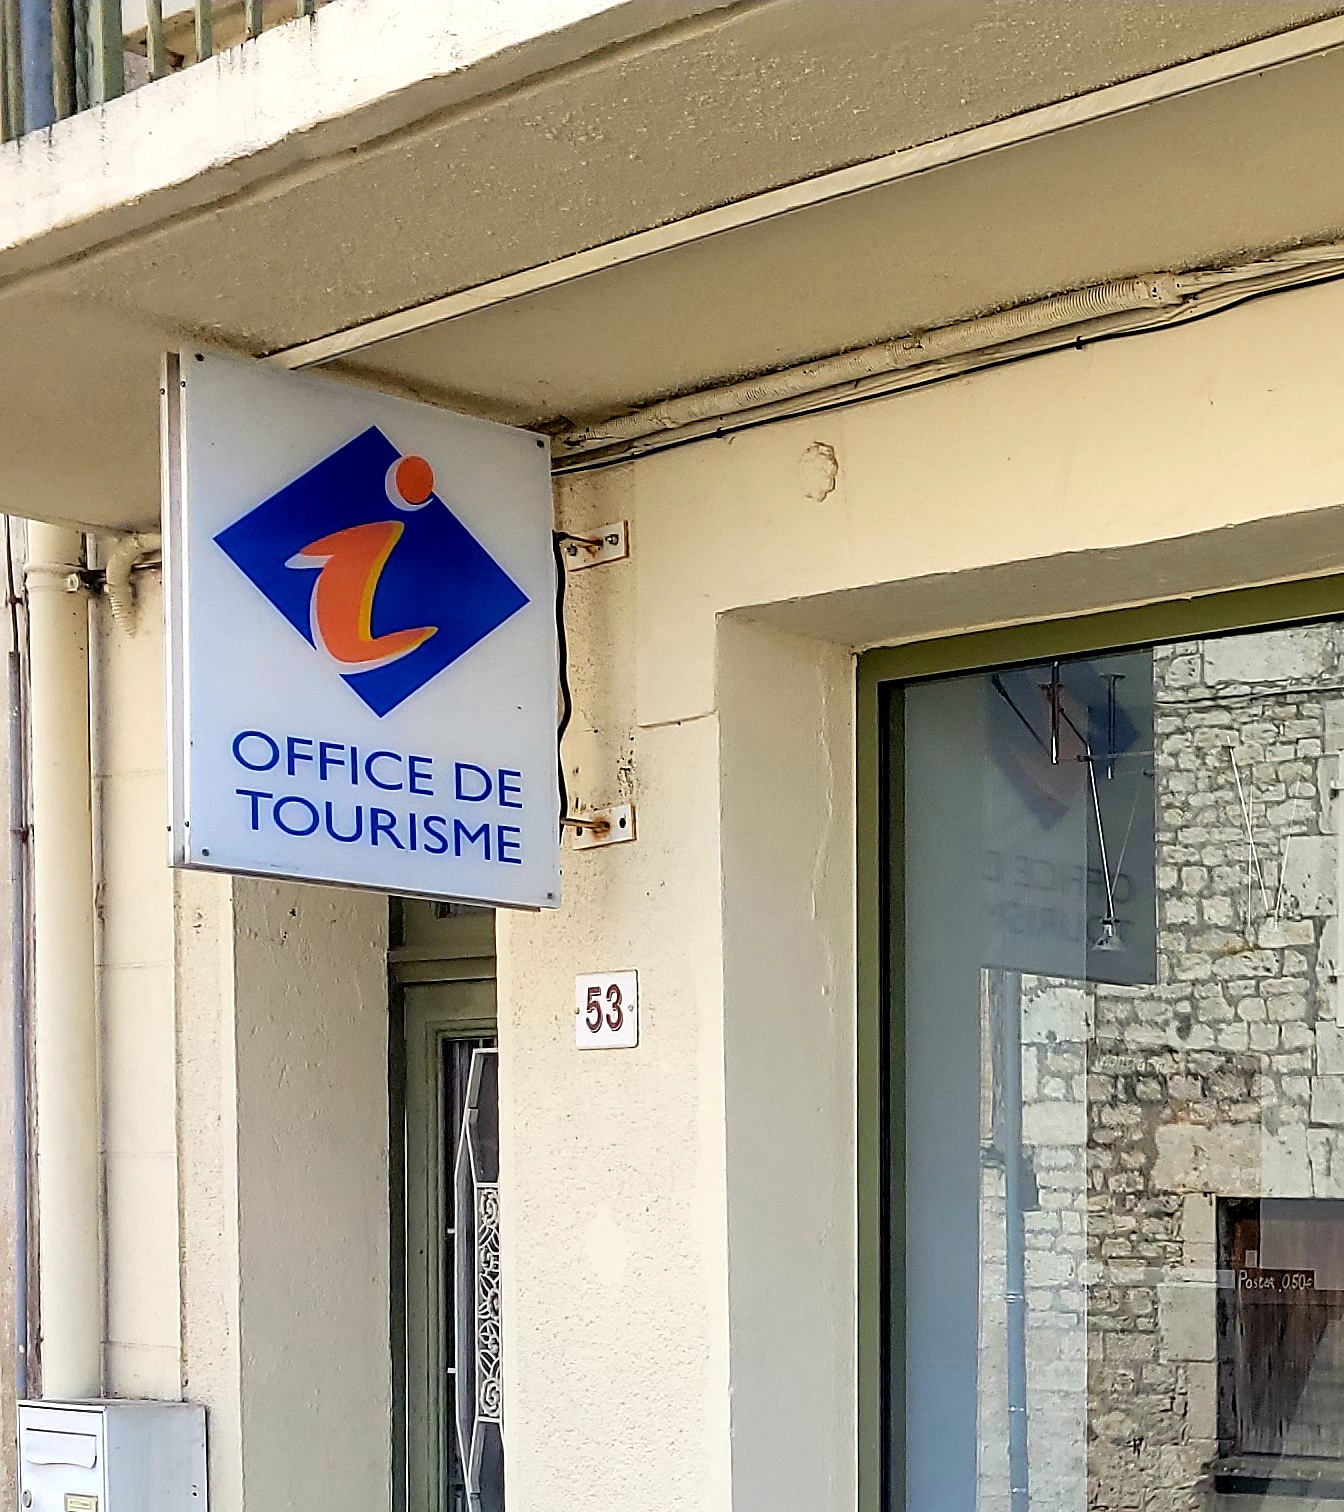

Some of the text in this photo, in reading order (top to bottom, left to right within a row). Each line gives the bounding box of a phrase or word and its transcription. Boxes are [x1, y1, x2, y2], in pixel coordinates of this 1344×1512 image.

[232, 730, 523, 809] OFFICE DE
[235, 788, 523, 865] TOURISME
[586, 984, 623, 1033] 53
